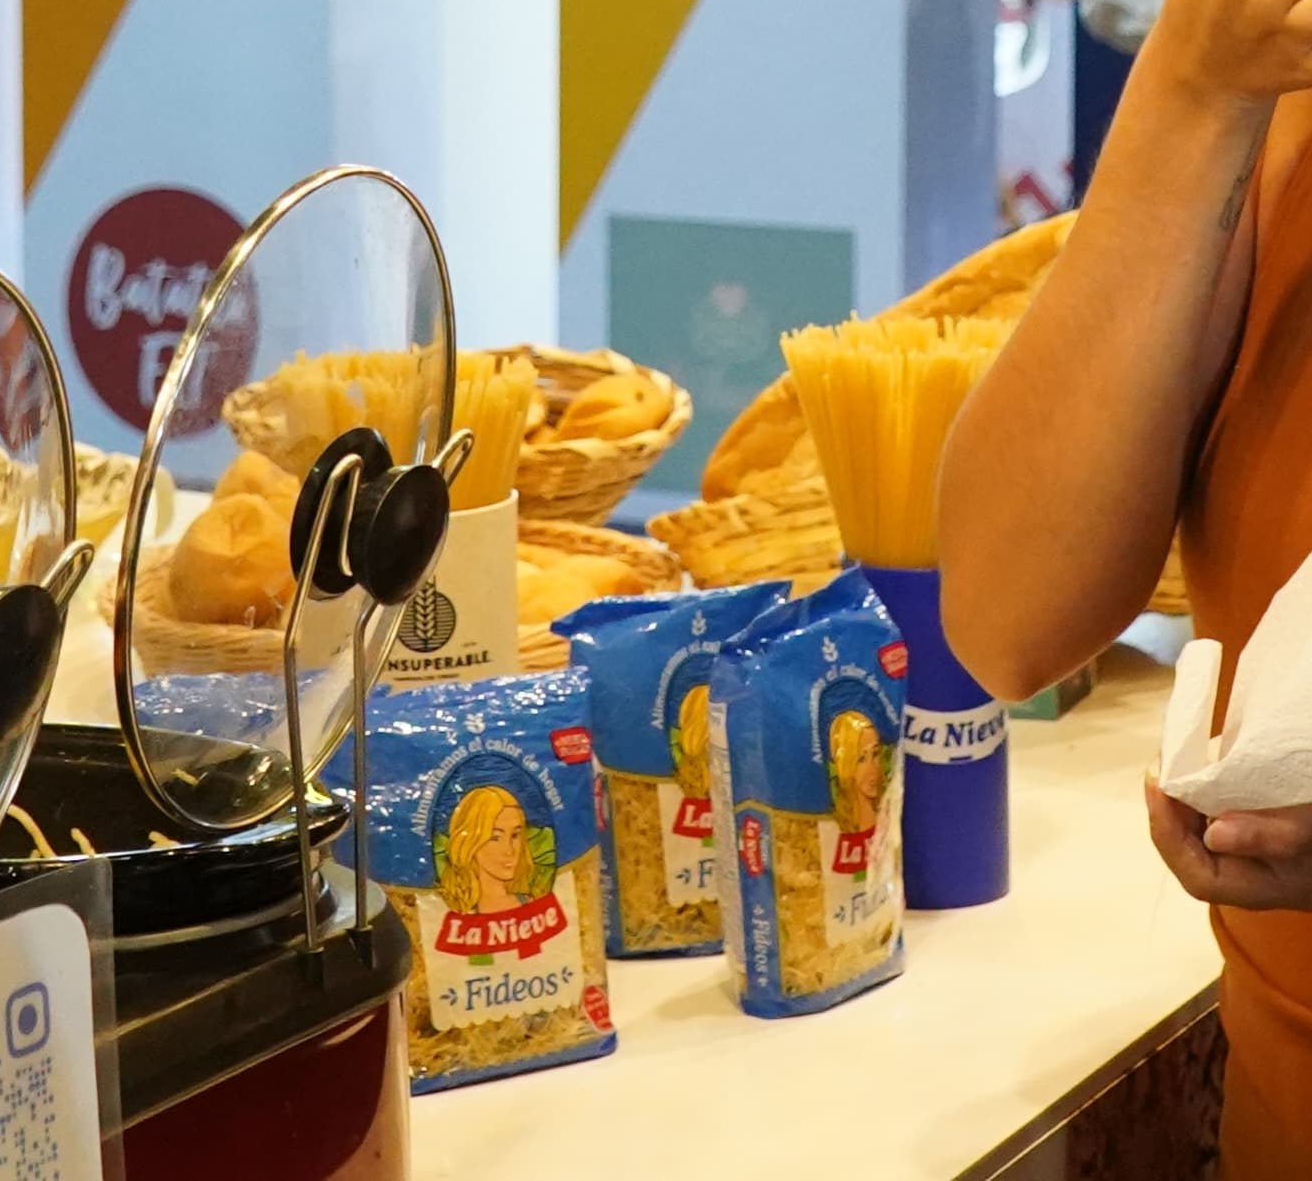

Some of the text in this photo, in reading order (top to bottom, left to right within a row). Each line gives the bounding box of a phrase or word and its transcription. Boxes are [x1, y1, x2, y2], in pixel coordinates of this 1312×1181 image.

[388, 651, 491, 672] NSUPERABLE
[903, 714, 936, 745] La
[446, 906, 559, 946] La Nieve
[464, 971, 559, 1012] Fideos
